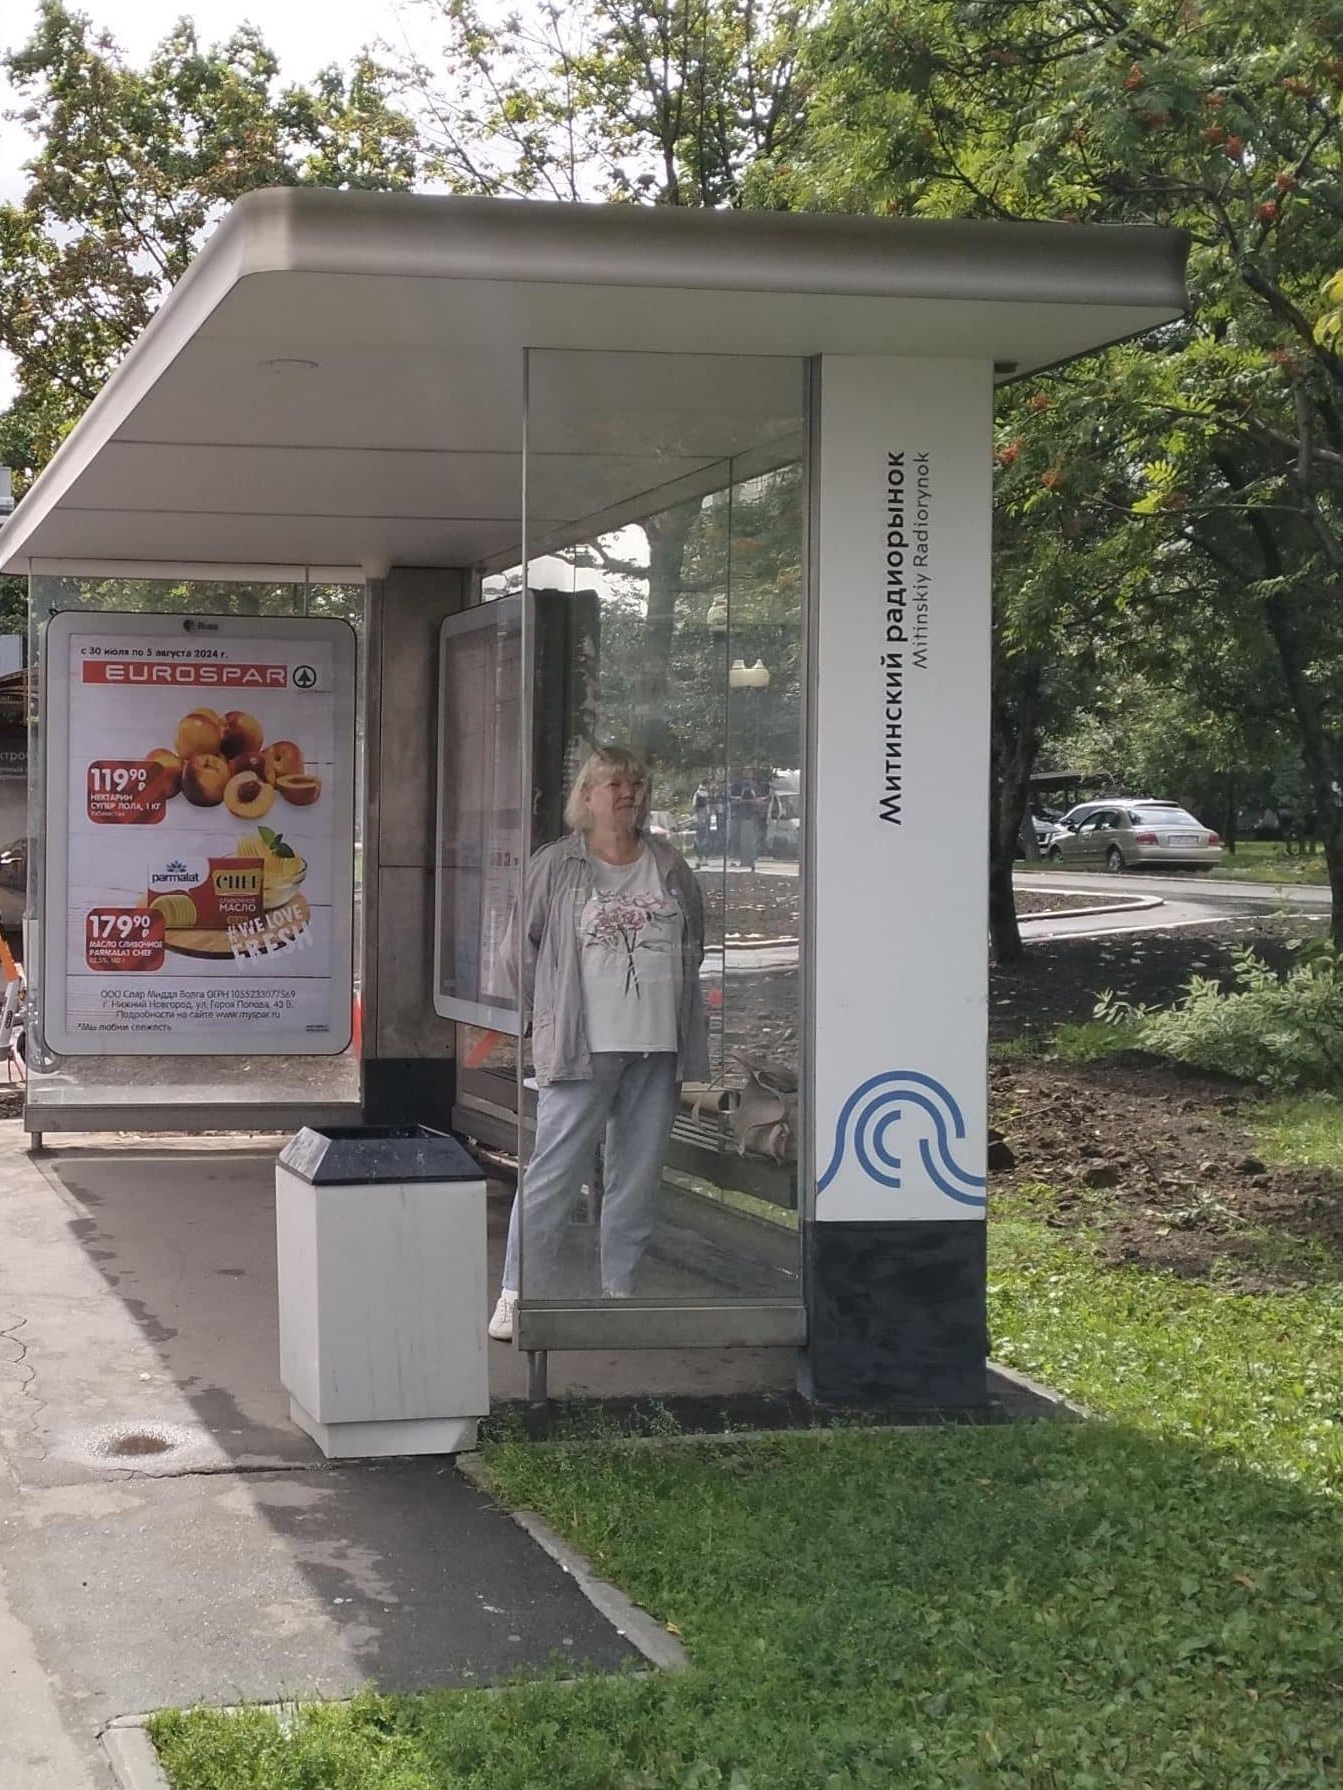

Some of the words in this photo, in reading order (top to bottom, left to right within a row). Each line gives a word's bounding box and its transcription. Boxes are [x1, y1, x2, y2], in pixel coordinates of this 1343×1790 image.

[912, 451, 933, 567] Radiorynok
[886, 451, 909, 642] радиорынок
[912, 573, 932, 669] Mitinskiy
[89, 646, 101, 656] 30
[104, 648, 129, 657] июля
[132, 649, 144, 657] по
[146, 648, 152, 657] 5
[155, 649, 192, 659] августа
[195, 649, 218, 659] 2024
[105, 664, 286, 684] EUROSPAR
[879, 653, 902, 826] Митинский
[152, 873, 199, 883] parmalat
[219, 903, 257, 912] МАСЛО
[226, 917, 265, 944] #WE
[265, 904, 303, 930] LOVE
[230, 920, 314, 972] FRESH
[100, 990, 121, 999] ООО
[123, 990, 146, 1000] Спар
[147, 990, 178, 999] Миддл
[179, 990, 205, 999] Волга
[206, 990, 229, 999] ОГРН
[111, 1001, 147, 1009] Нижний
[210, 1001, 235, 1010] Героя
[116, 1010, 174, 1020] Подробности
[189, 1011, 214, 1019] сайте
